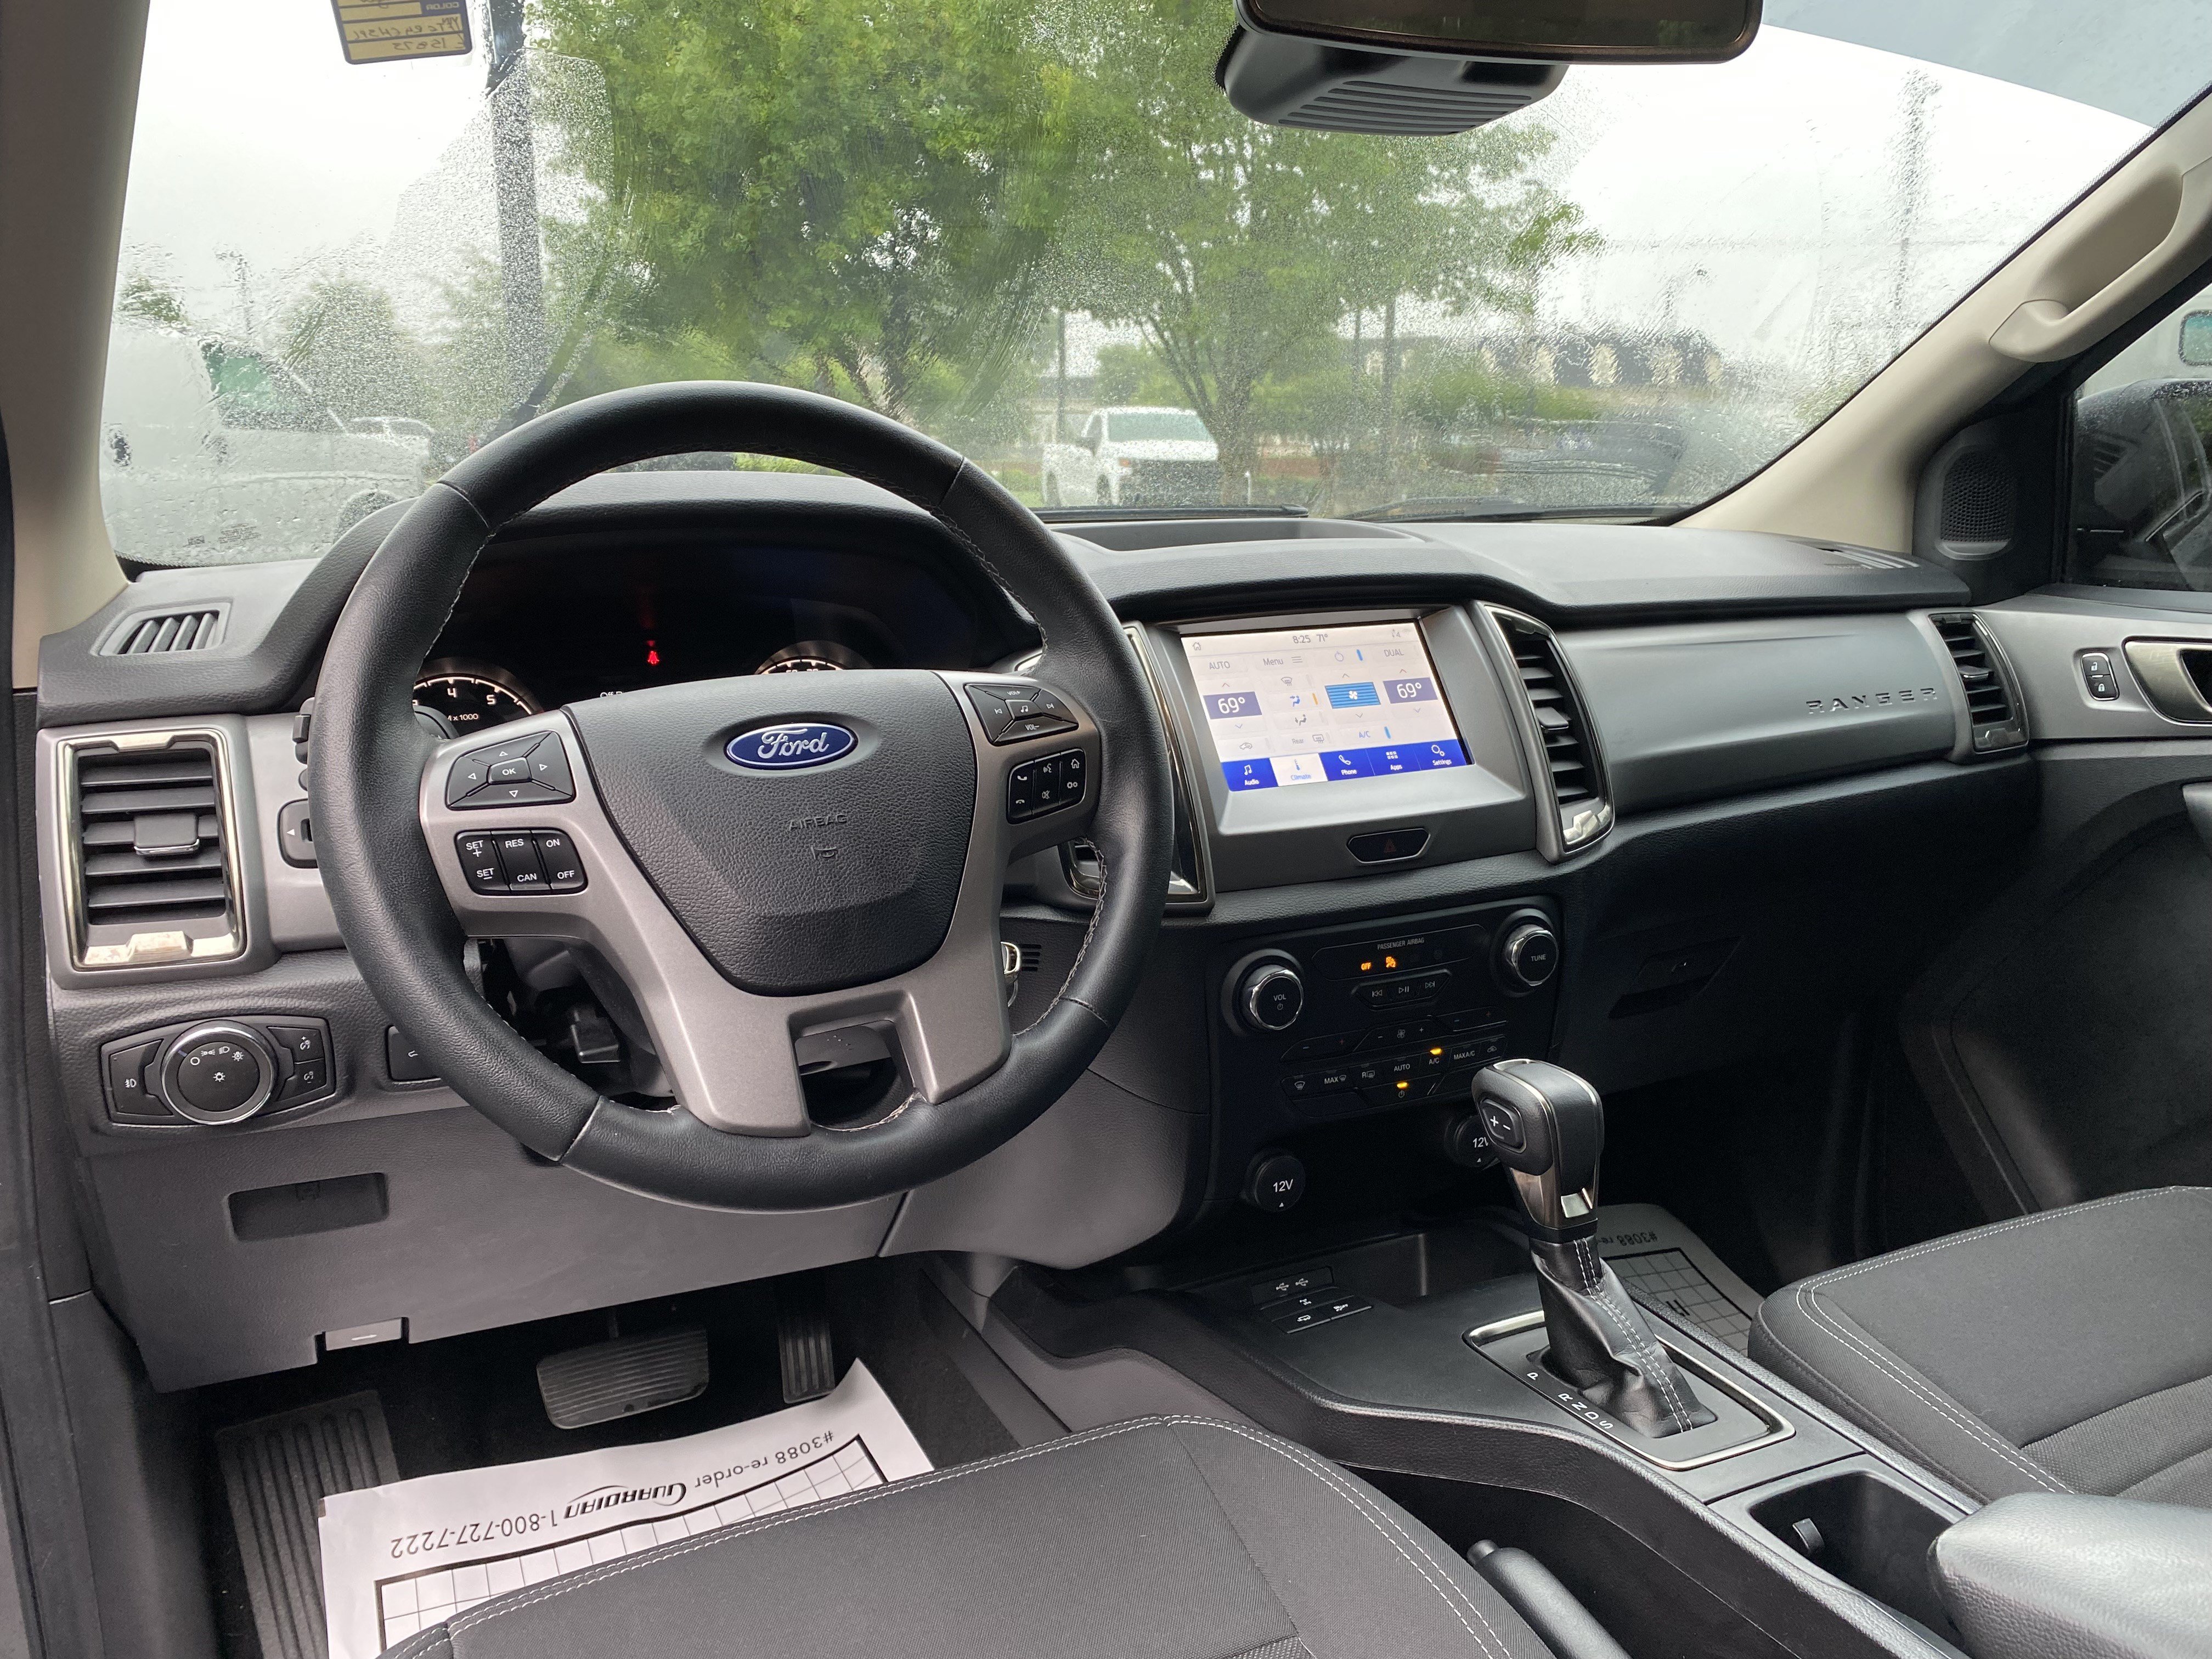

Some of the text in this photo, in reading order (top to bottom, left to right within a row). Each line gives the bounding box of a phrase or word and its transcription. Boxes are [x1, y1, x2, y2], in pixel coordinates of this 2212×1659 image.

[1293, 635, 1311, 644] 8:25
[1384, 649, 1404, 657] DUAL
[1209, 661, 1231, 670] AUTO
[1263, 658, 1284, 666] Menu
[447, 688, 456, 698] 4
[1396, 682, 1422, 699] 69°
[487, 695, 496, 705] 5
[1217, 696, 1245, 714] 69°
[1806, 688, 1938, 714] RANGER
[757, 728, 830, 759] Ford
[1291, 773, 1312, 781] Climate
[789, 814, 848, 831] AIRBAG
[466, 840, 483, 850] SET
[505, 838, 524, 848] RES
[546, 838, 560, 848] ON
[477, 868, 494, 878] SET
[517, 873, 537, 882] CAN
[557, 870, 575, 879] OFF
[1377, 937, 1425, 950] PASSENGER AIRBAG
[1361, 962, 1372, 970] OFF
[1393, 1063, 1410, 1072] AUTO
[1324, 1075, 1339, 1085] MAX
[1473, 1137, 1489, 1148] 12V
[1273, 1178, 1293, 1193] 12V
[1617, 1231, 1658, 1246] #3088
[775, 1430, 834, 1464] #3088
[695, 1455, 768, 1488] re-order
[391, 1510, 558, 1558] 1-800-727-7222
